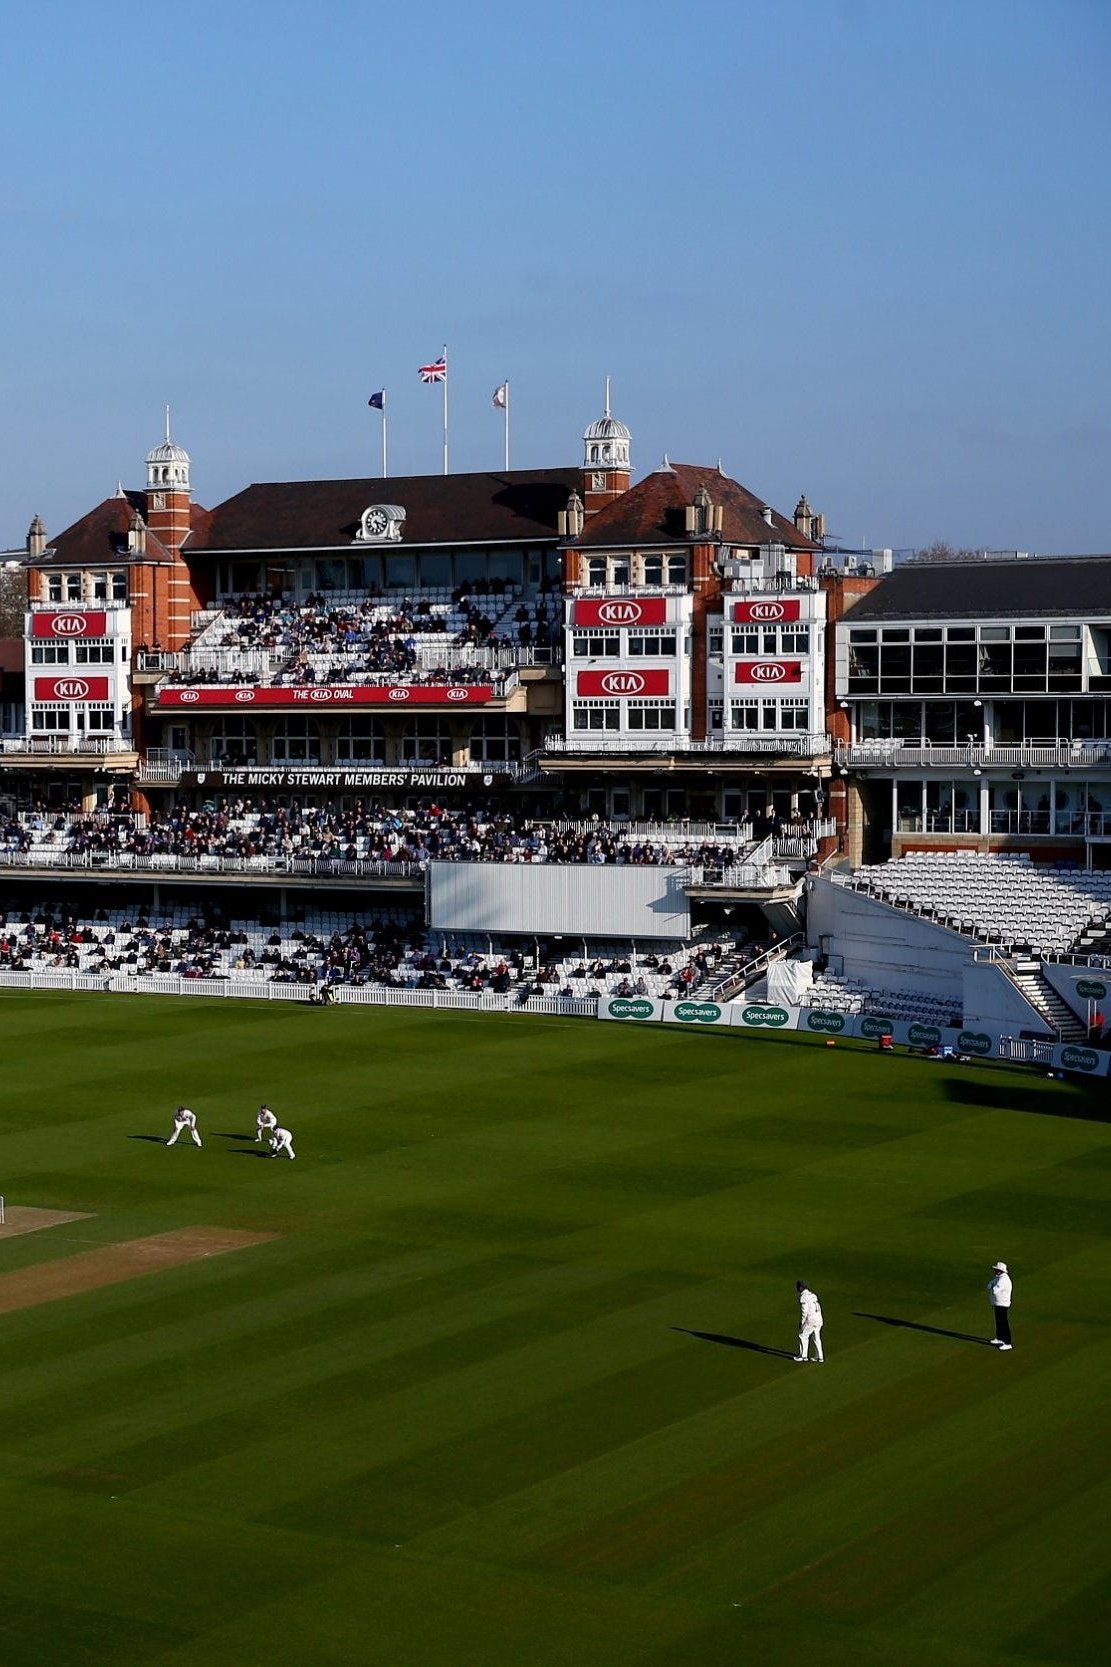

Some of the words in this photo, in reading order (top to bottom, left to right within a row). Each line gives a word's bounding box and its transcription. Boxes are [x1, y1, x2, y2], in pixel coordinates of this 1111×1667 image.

[606, 606, 634, 619] KIA
[755, 605, 779, 616] KIA
[58, 619, 80, 630] KIA
[756, 668, 780, 679] KIA
[60, 683, 83, 695] KIA
[608, 676, 637, 690] KIA
[293, 690, 309, 699] THE
[333, 690, 354, 699] OVAL
[223, 773, 245, 785] THE
[247, 773, 285, 785] MICKY
[287, 773, 341, 785] STEWART
[344, 773, 407, 785] MEMBERS'
[410, 774, 466, 786] PAVILION
[612, 1003, 650, 1015] Specsavers
[678, 1006, 717, 1019] Specsavers
[746, 1010, 785, 1022] Specsavers
[810, 1014, 842, 1028] Specsavers
[910, 1028, 939, 1042] Specsavers
[959, 1034, 989, 1050] Specsavers
[1063, 1050, 1096, 1067] Specsavers
